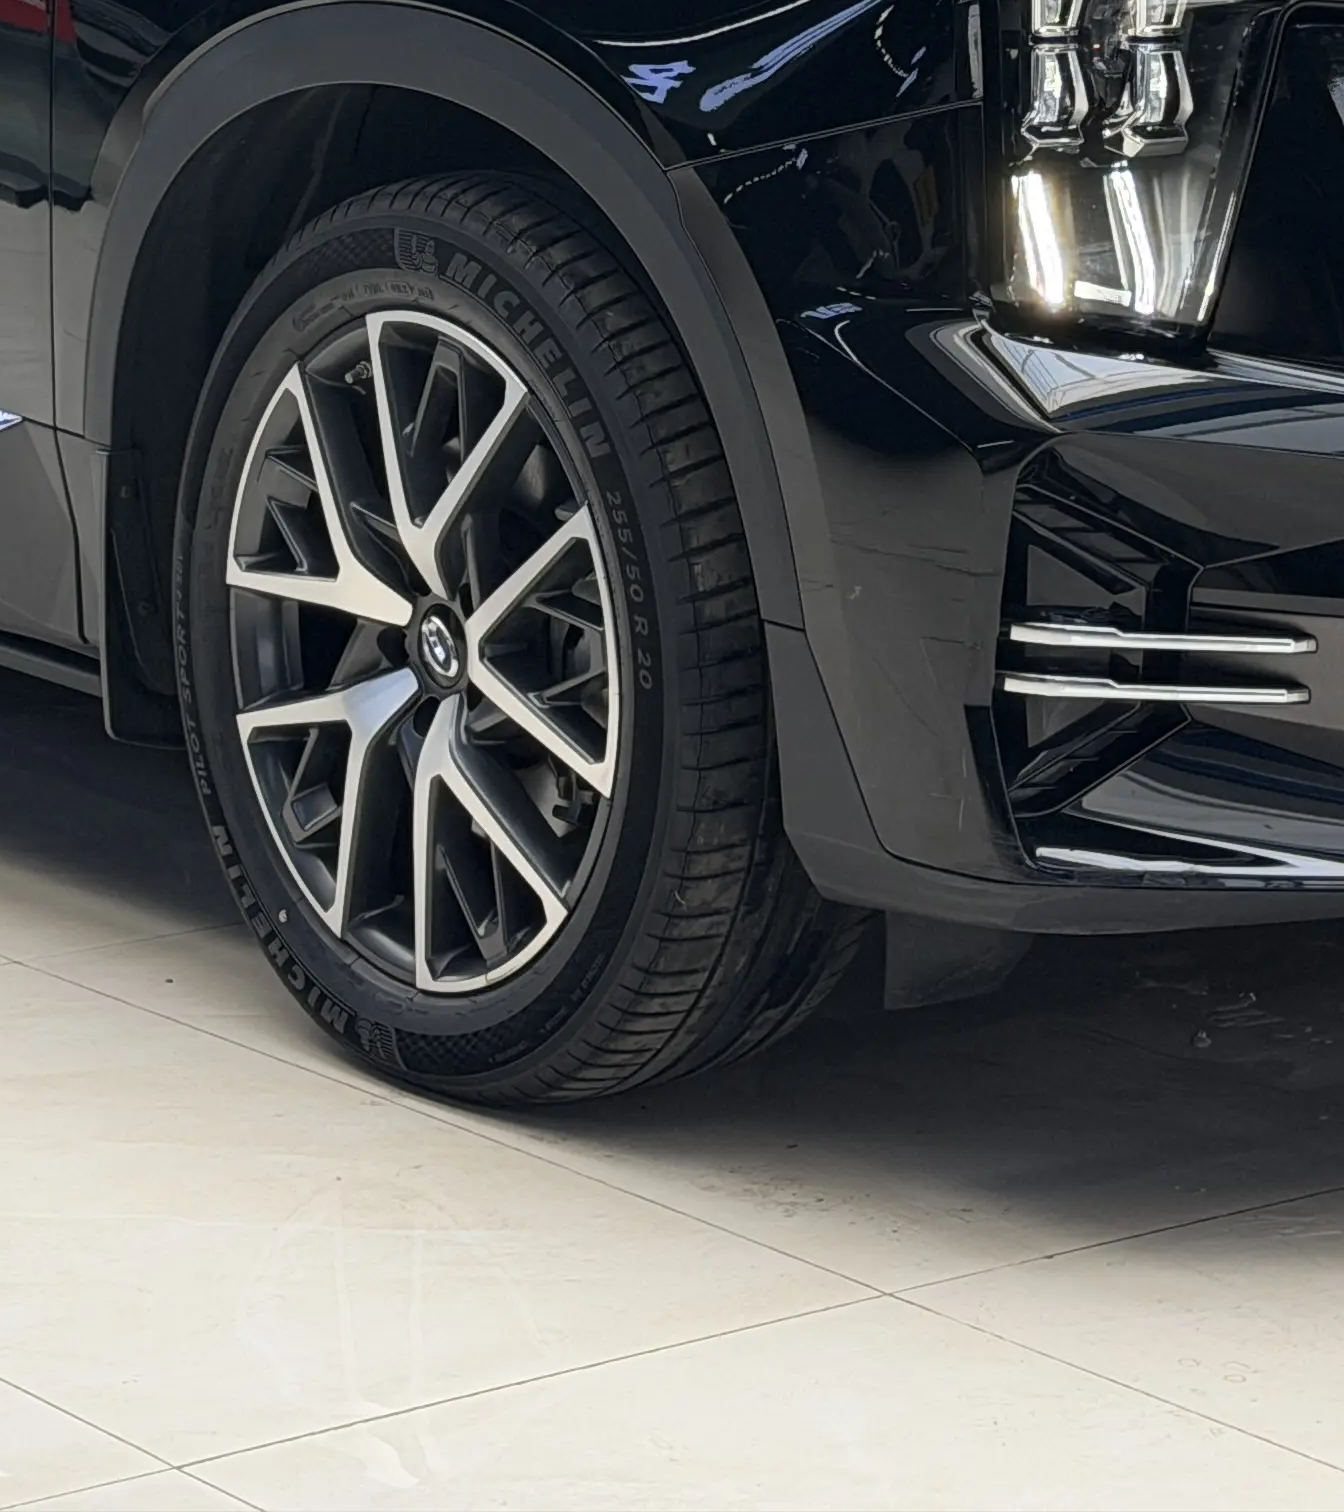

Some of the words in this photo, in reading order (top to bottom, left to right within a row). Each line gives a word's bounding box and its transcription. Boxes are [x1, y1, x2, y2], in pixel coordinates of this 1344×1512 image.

[445, 252, 612, 459] MICHELIN
[606, 490, 644, 603] 255/50
[175, 602, 193, 705] SPORT
[633, 614, 649, 637] R
[637, 646, 653, 690] 20
[184, 719, 211, 796] PILOT
[211, 825, 349, 1035] MICHELIN
